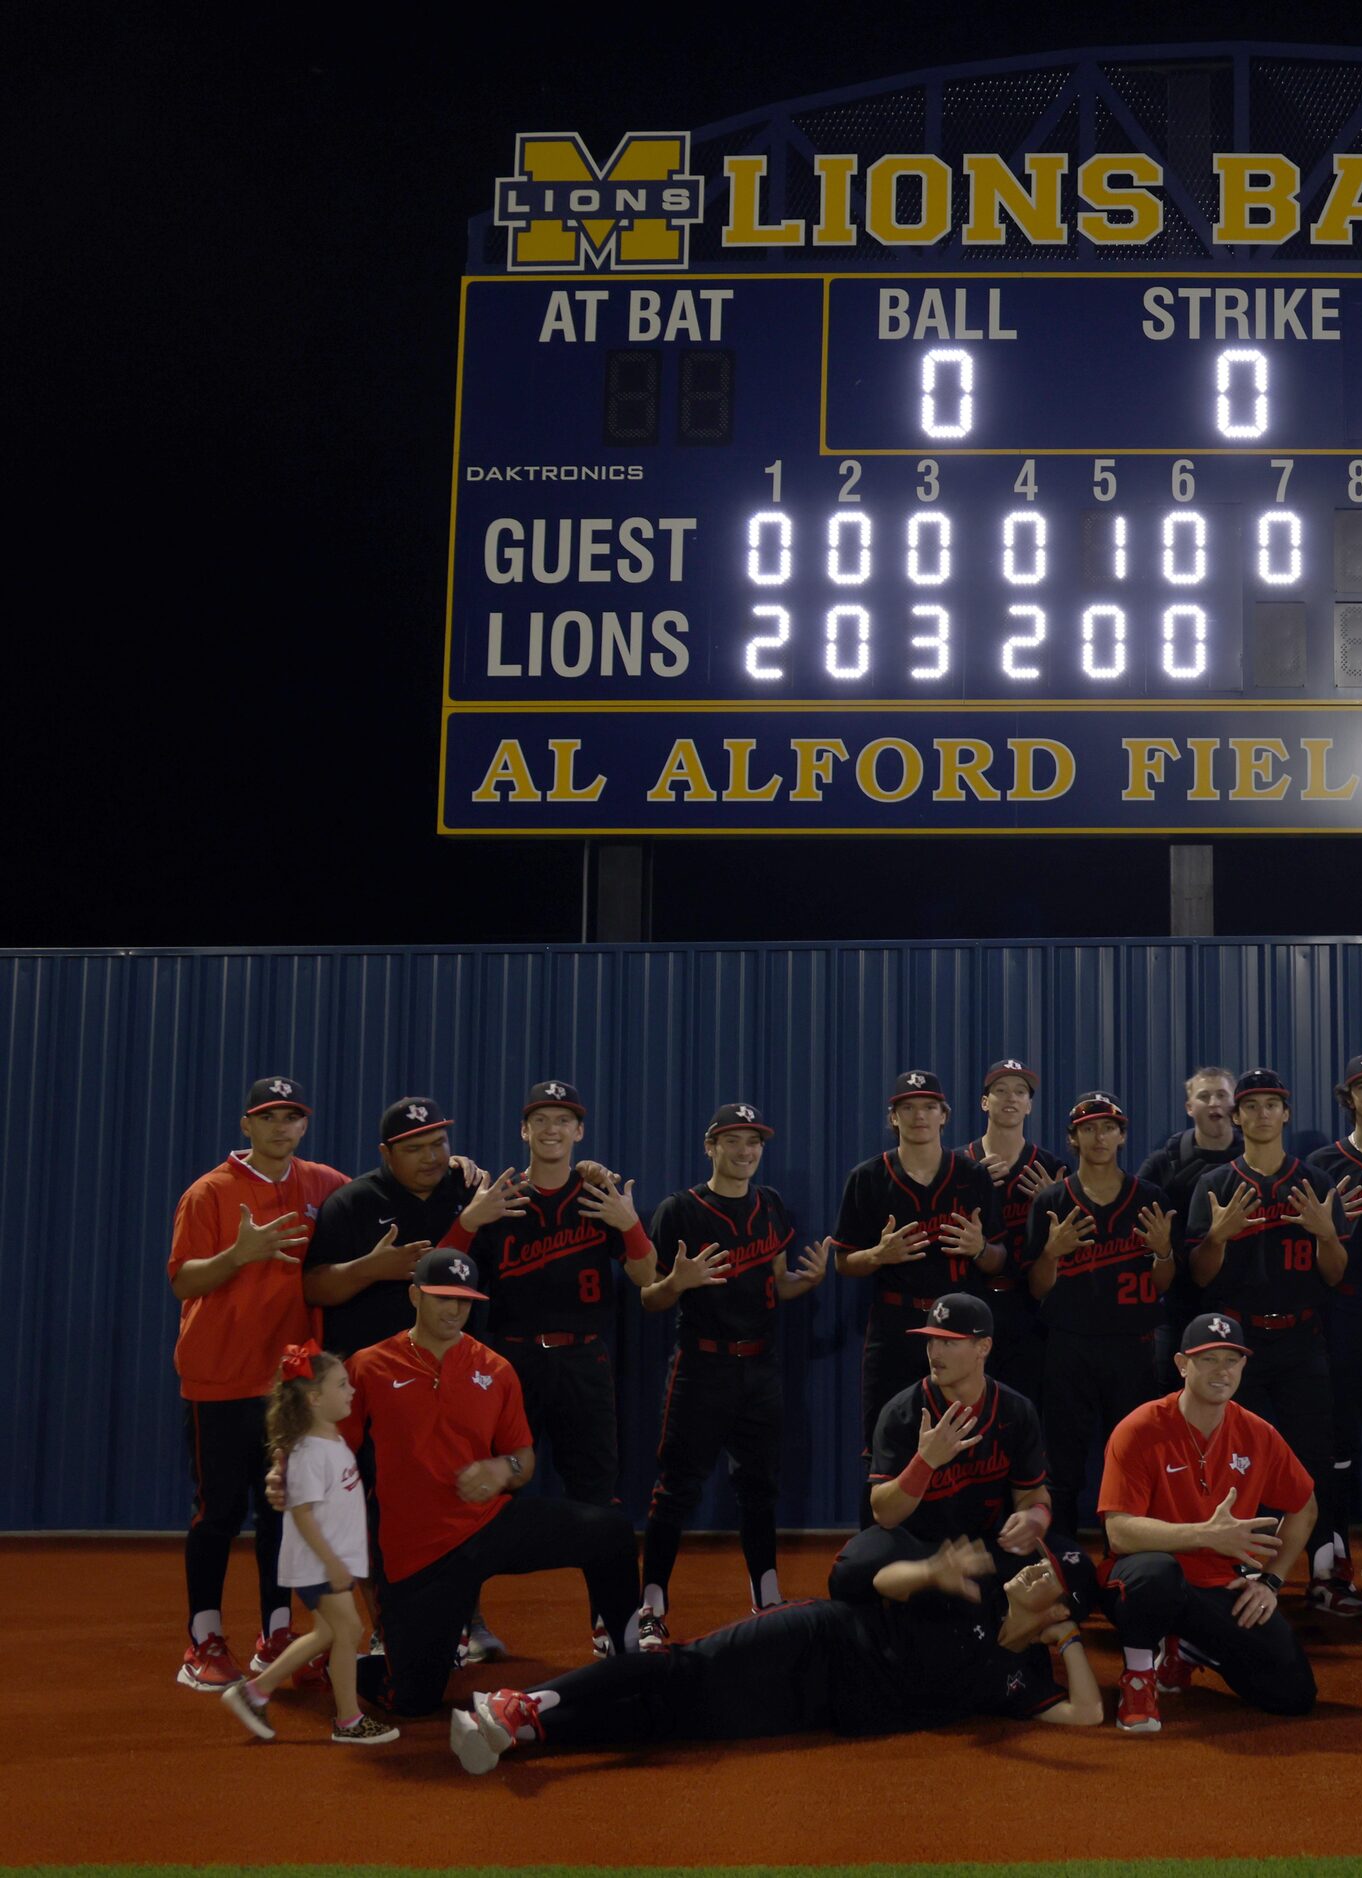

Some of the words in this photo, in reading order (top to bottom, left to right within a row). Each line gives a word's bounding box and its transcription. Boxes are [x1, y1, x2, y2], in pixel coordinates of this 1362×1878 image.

[507, 189, 691, 213] LIONS
[722, 153, 1163, 247] LIONS
[539, 290, 608, 343] AT
[628, 289, 734, 343] BAT
[879, 288, 1018, 341] BALL
[1142, 288, 1341, 341] STRIKE
[921, 349, 973, 438] 0
[1216, 349, 1268, 438] 0
[466, 465, 644, 481] DAKTRONICS
[764, 460, 783, 502] 1
[838, 460, 861, 502] 2
[916, 460, 940, 502] 3
[1014, 460, 1038, 502] 4
[1093, 460, 1116, 502] 5
[1171, 460, 1195, 502] 6
[1270, 460, 1294, 502] 7
[484, 518, 697, 584] GUEST
[747, 512, 793, 585] 0
[828, 512, 872, 585] 0
[908, 512, 951, 585] 0
[1003, 512, 1047, 585] 0
[1114, 516, 1127, 579] 1
[1163, 512, 1206, 585] 0
[1258, 511, 1301, 585] 0
[487, 610, 690, 678] LIONS
[745, 605, 791, 679] 2
[826, 605, 870, 679] 0
[911, 605, 950, 679] 3
[1002, 605, 1046, 679] 2
[1082, 605, 1125, 679] 0
[1163, 605, 1206, 679] 0
[471, 738, 607, 803] AL
[646, 737, 1076, 804] ALFORD
[498, 1215, 600, 1270] Leopards
[1281, 1238, 1312, 1271] 18
[578, 1268, 601, 1304] 8
[1116, 1271, 1157, 1305] 20
[983, 1497, 1004, 1527] 7
